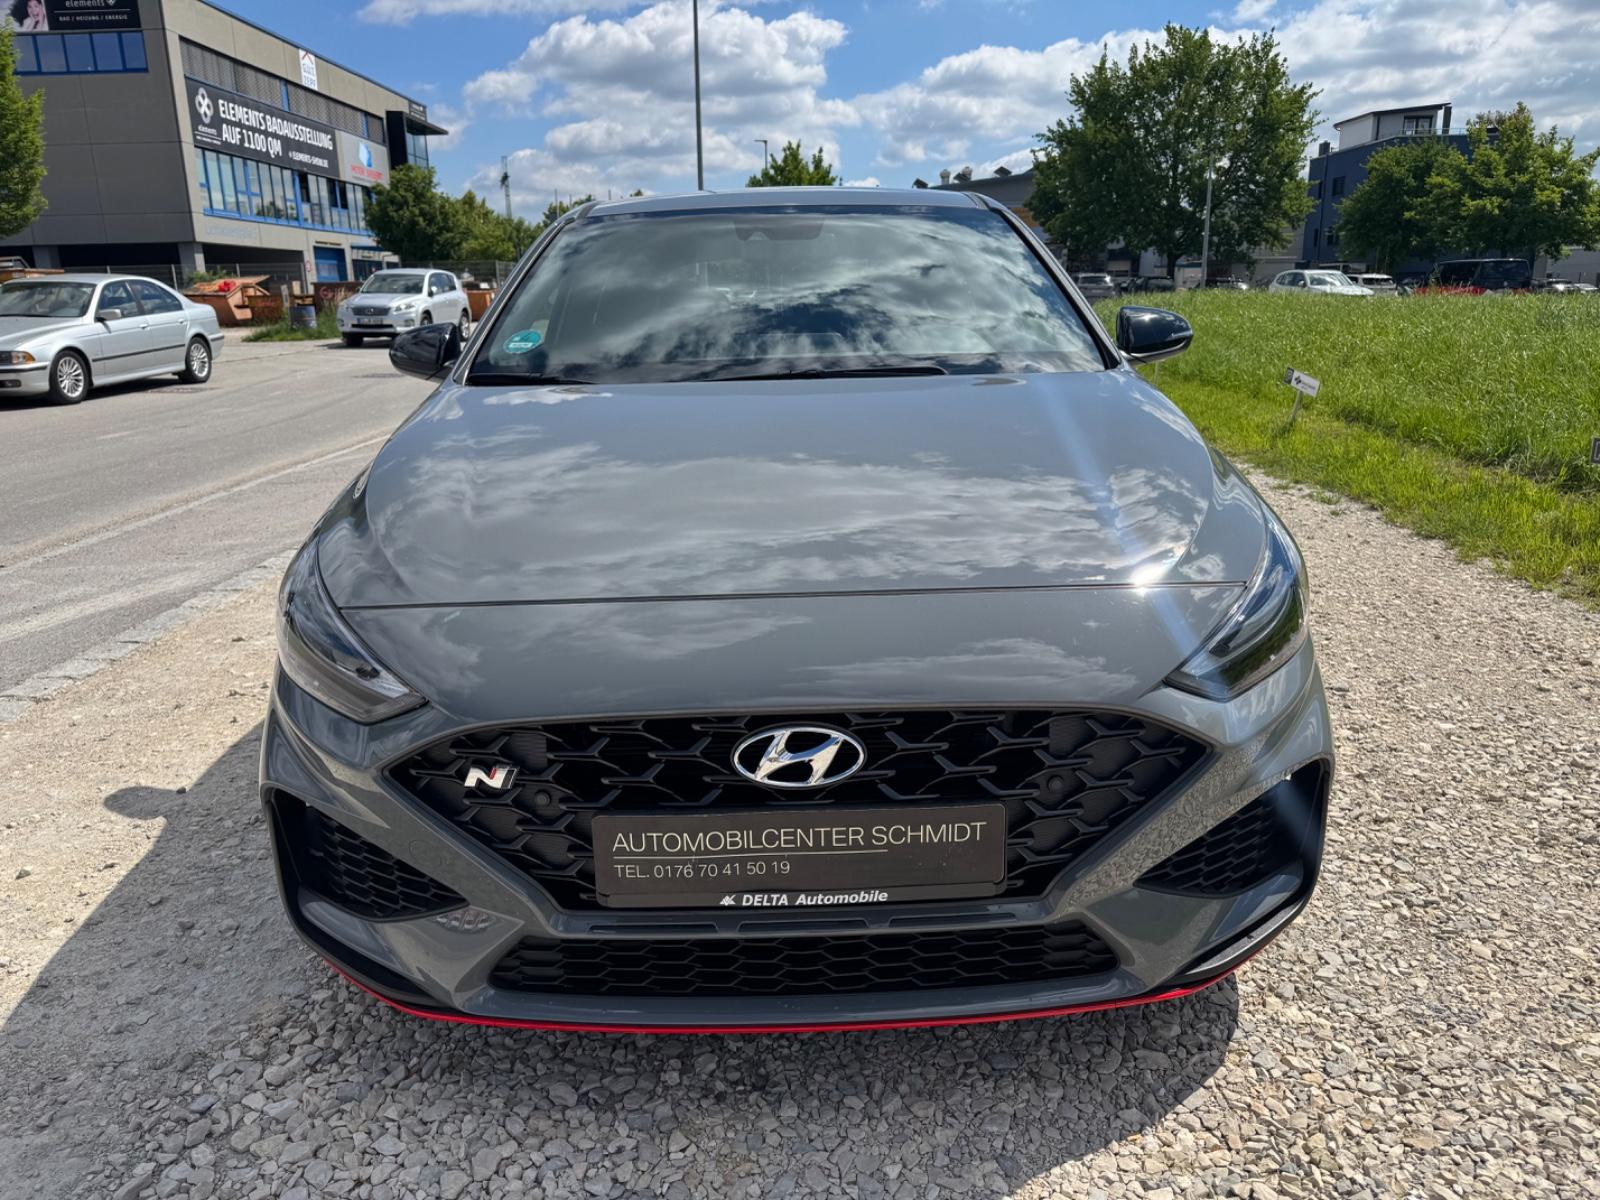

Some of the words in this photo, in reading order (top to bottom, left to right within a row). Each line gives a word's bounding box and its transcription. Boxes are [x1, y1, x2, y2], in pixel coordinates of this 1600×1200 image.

[219, 99, 266, 130] ELEMENTS
[266, 114, 333, 150] BADAUSSTELLUNG
[222, 123, 241, 145] AUF
[243, 129, 267, 152] 1100
[267, 136, 283, 159] QM
[612, 826, 865, 852] AUTOMOBILCENTER
[872, 821, 987, 846] SCHMIDT
[614, 864, 650, 879] TEL.
[653, 863, 694, 879] 0176
[699, 863, 718, 878] 70
[722, 862, 741, 877] 41
[746, 861, 766, 876] 50
[771, 860, 791, 875] 19
[742, 892, 789, 906] DELTA
[795, 889, 889, 906] Automobile
